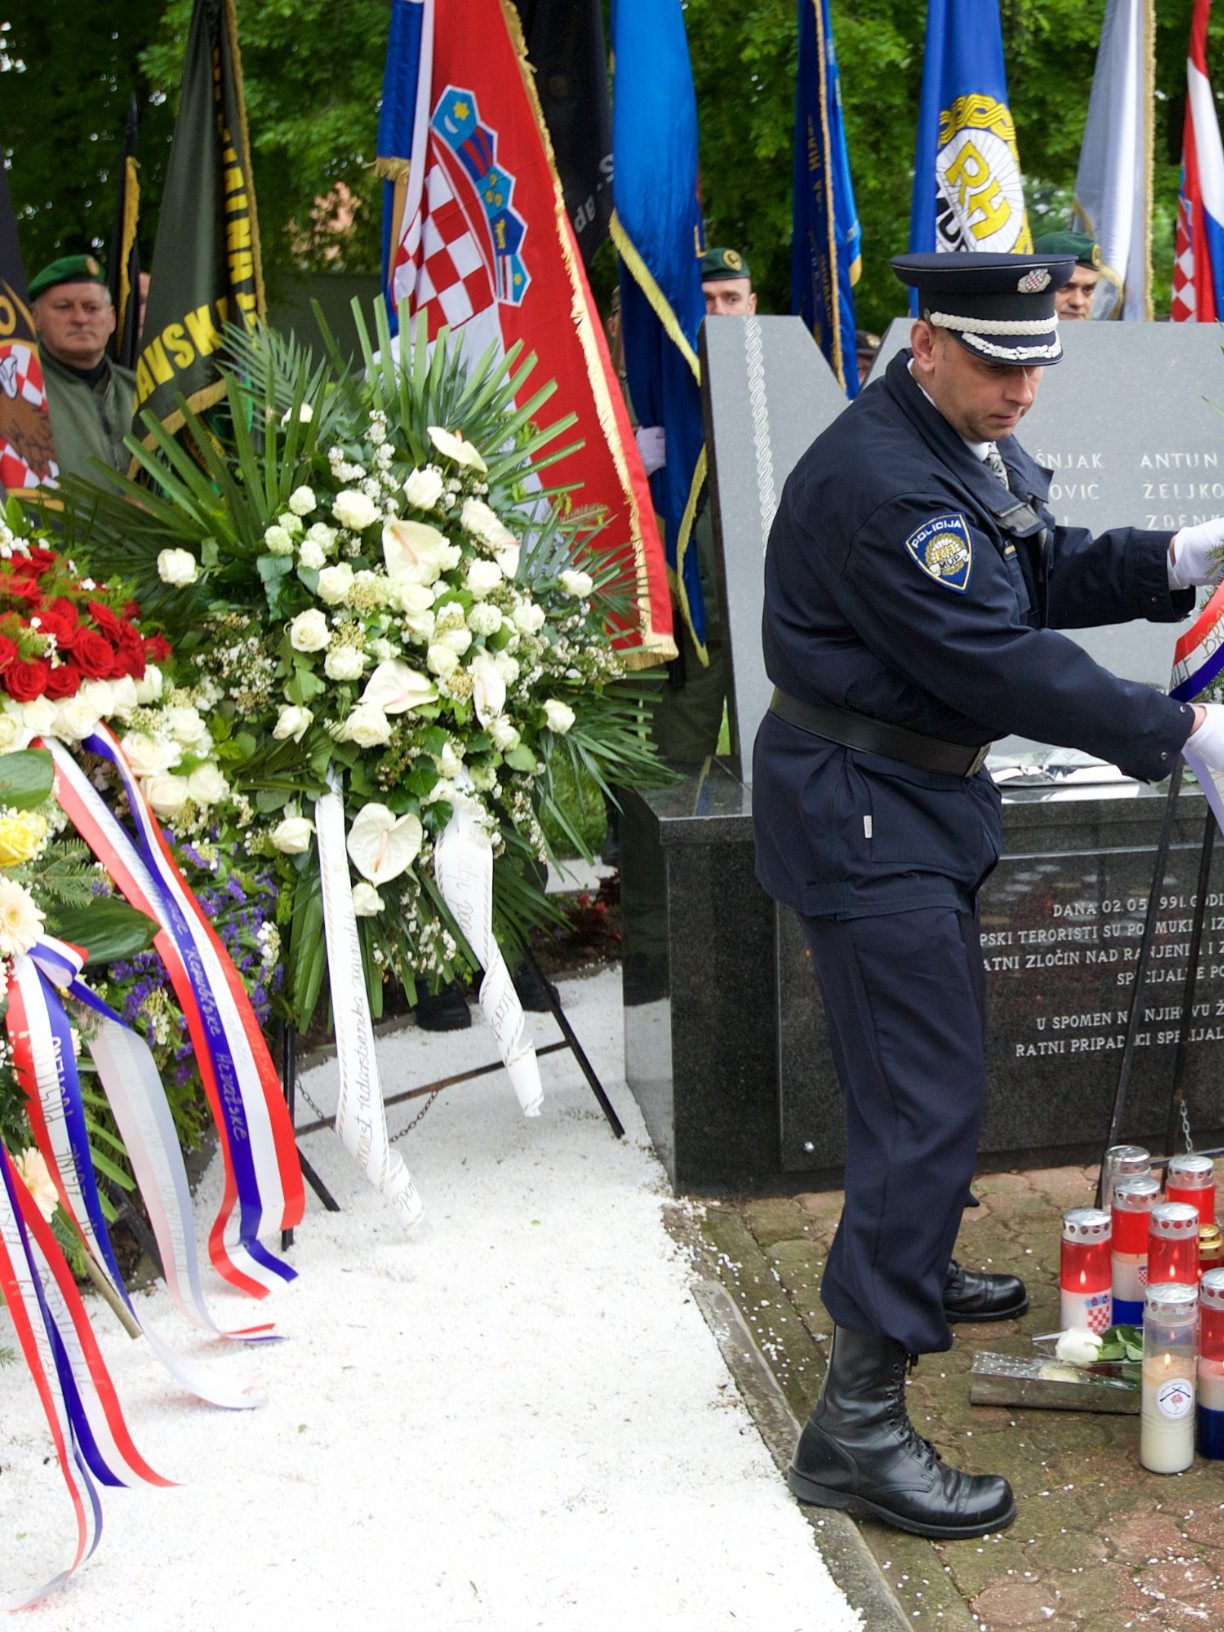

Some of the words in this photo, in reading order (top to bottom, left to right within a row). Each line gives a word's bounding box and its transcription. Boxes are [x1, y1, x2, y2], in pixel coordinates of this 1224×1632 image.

[945, 139, 1012, 241] RH
[1035, 449, 1104, 469] ŠNJAK
[1140, 452, 1218, 469] ANTUN
[1048, 483, 1101, 500] OVIĆ
[911, 520, 962, 548] POLICIJA
[940, 554, 960, 569] MUP
[1053, 903, 1097, 917] DANA
[980, 931, 1012, 946] PSKI
[1017, 926, 1098, 944] TERORISTI
[1103, 924, 1121, 937] SU
[983, 955, 1019, 972] ATNI
[1025, 950, 1080, 969] ZLOČIN
[1086, 949, 1118, 964] NAD
[1036, 1018, 1046, 1030] U
[1052, 1012, 1112, 1029] SPOMEN
[1144, 1004, 1210, 1022] NJIHVU
[1016, 1041, 1064, 1057] RATNI
